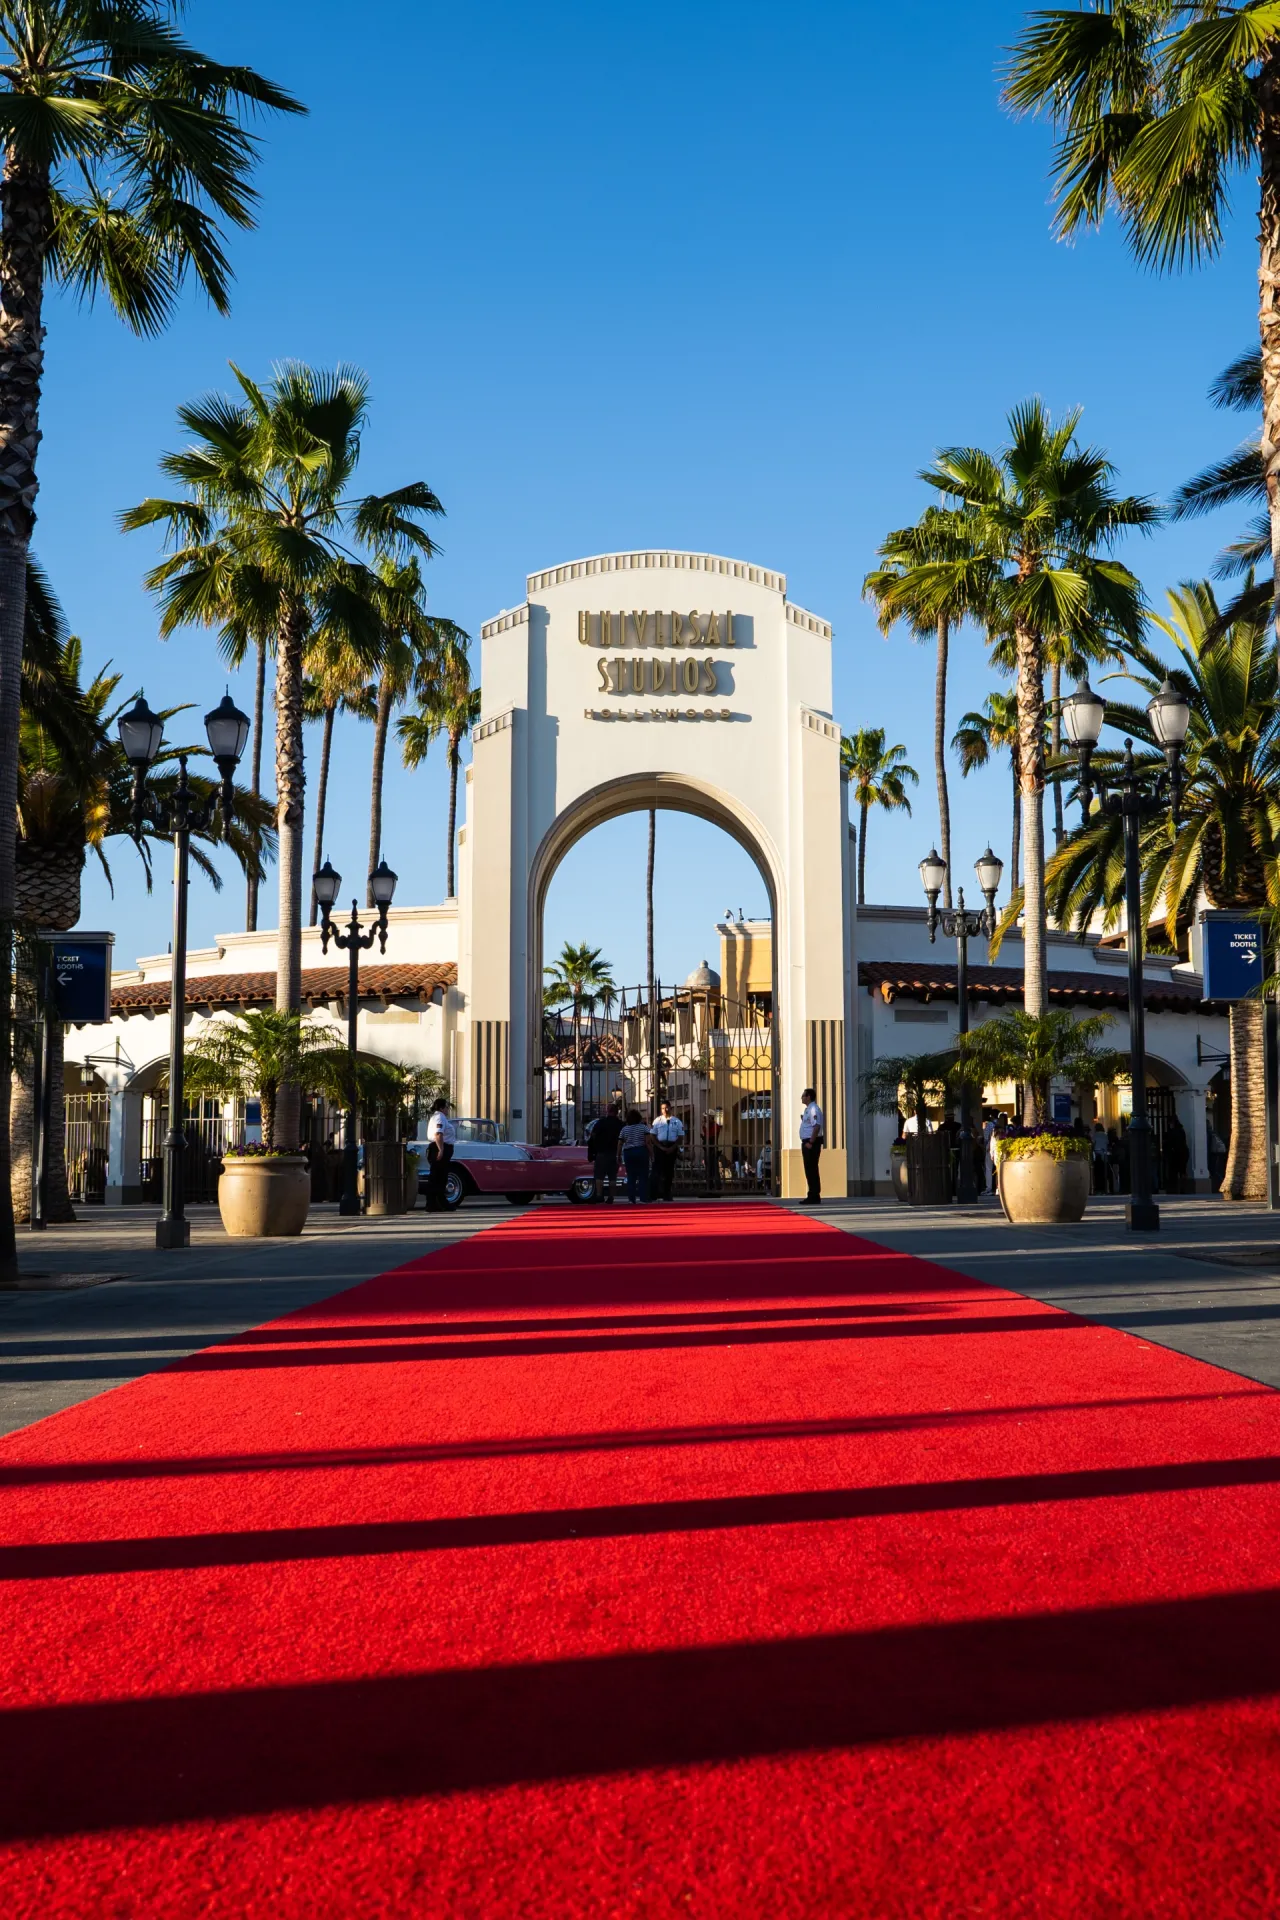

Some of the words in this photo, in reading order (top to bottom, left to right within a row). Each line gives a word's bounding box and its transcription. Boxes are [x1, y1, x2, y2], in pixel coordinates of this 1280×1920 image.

[578, 610, 736, 645] UNIVERSAL
[597, 657, 717, 692] STUDIOS
[584, 708, 731, 719] HOLLYWOOD
